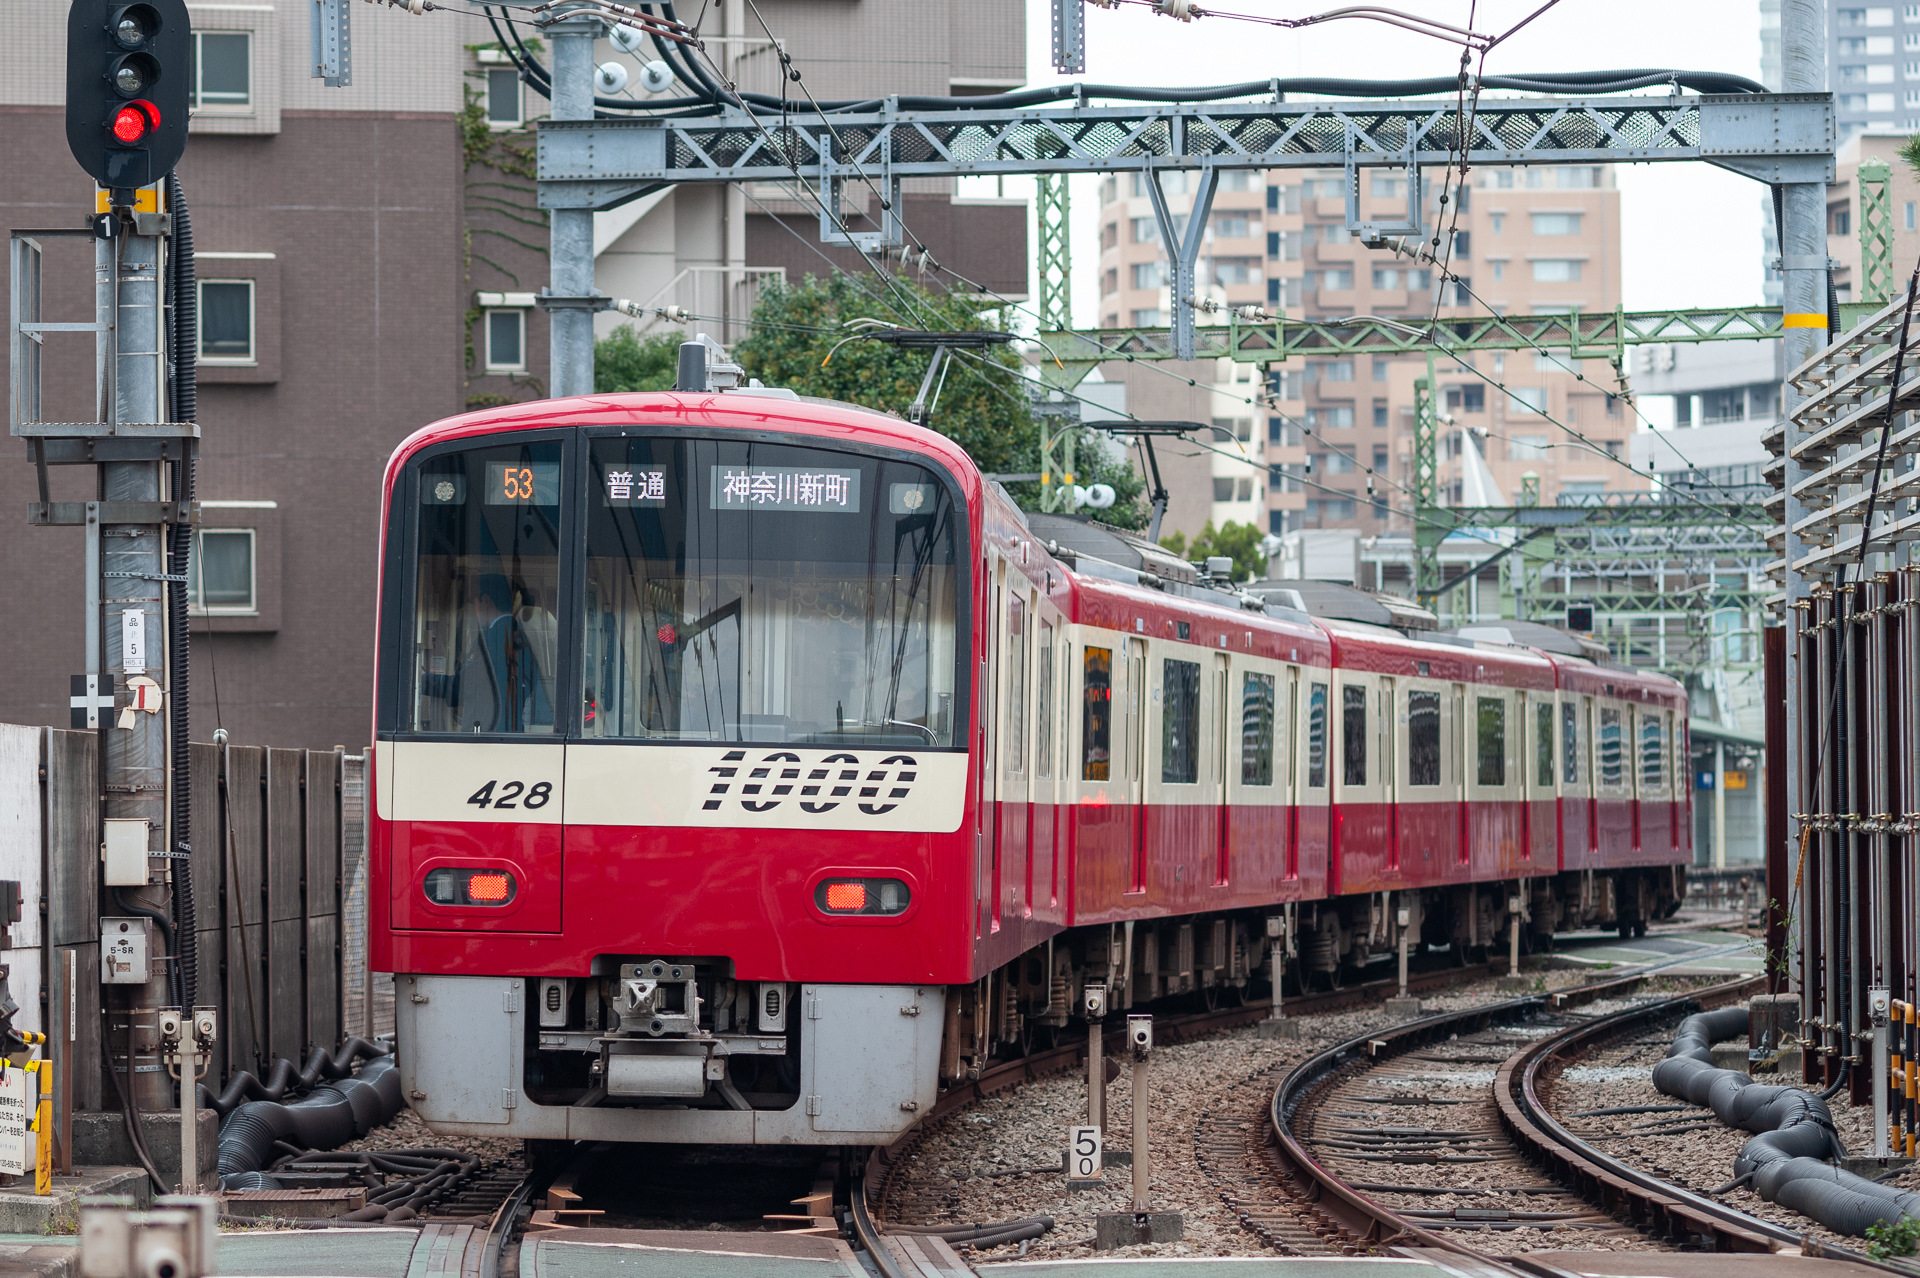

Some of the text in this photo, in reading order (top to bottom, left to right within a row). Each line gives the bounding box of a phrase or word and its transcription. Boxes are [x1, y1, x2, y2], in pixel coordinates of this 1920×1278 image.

[101, 216, 111, 237] 1
[504, 468, 533, 499] 53
[607, 471, 665, 500] 普通
[723, 470, 851, 506] 神奈川新町
[466, 780, 553, 810] 428
[702, 751, 917, 815] 1000
[110, 946, 134, 954] 5-SR
